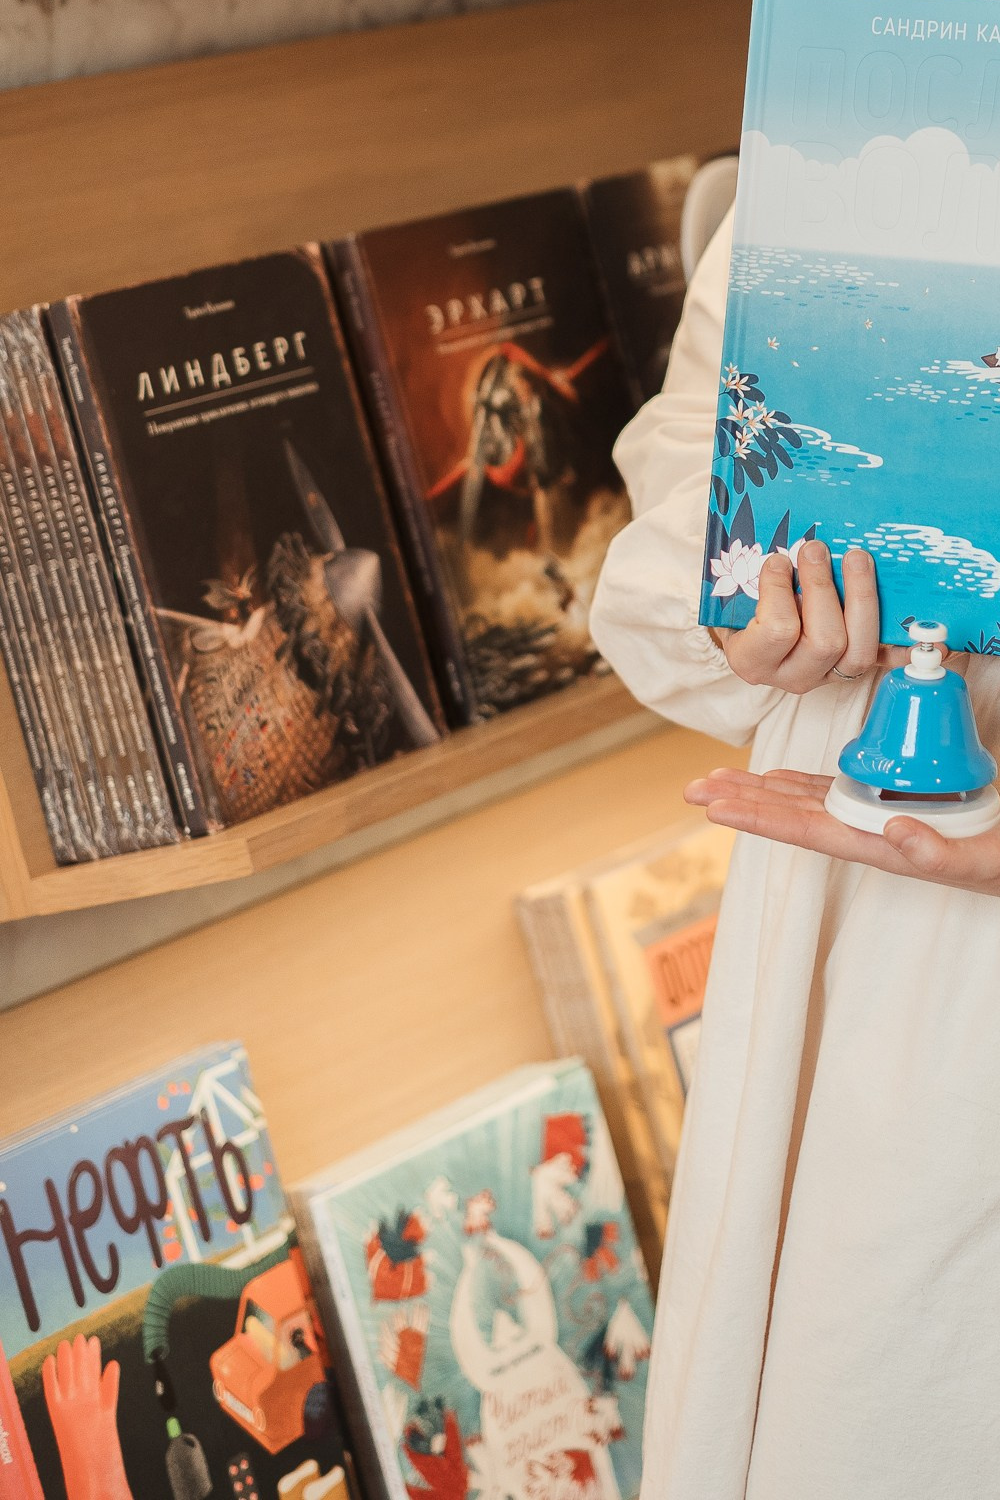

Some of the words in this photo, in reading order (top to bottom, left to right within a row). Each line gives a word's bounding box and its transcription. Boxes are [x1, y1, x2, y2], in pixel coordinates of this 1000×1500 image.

[870, 15, 968, 42] САНДРИН
[426, 276, 546, 335] ЭРХАРТ
[138, 330, 307, 402] ЛИНДБЕРГ
